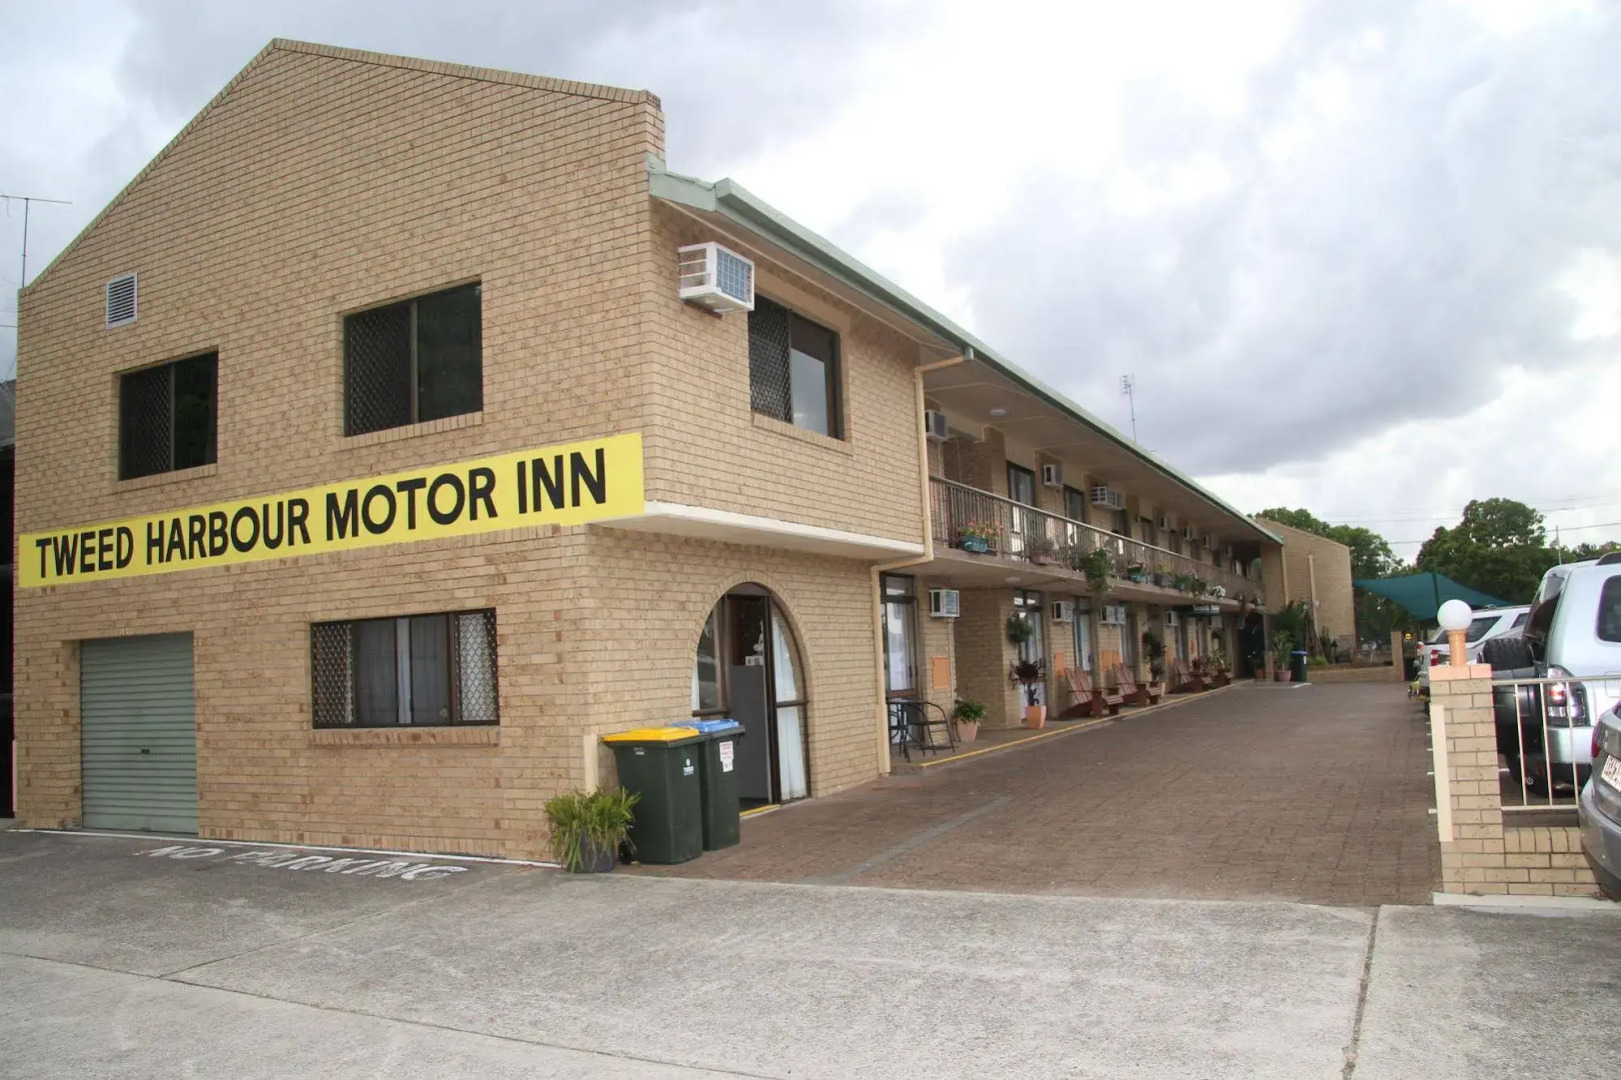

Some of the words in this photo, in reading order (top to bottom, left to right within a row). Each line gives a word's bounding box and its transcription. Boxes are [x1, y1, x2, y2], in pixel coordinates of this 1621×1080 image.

[35, 526, 134, 579] TWEED
[146, 499, 312, 566] HARBOUR
[326, 467, 498, 542] MOTOR
[516, 447, 606, 515] INN
